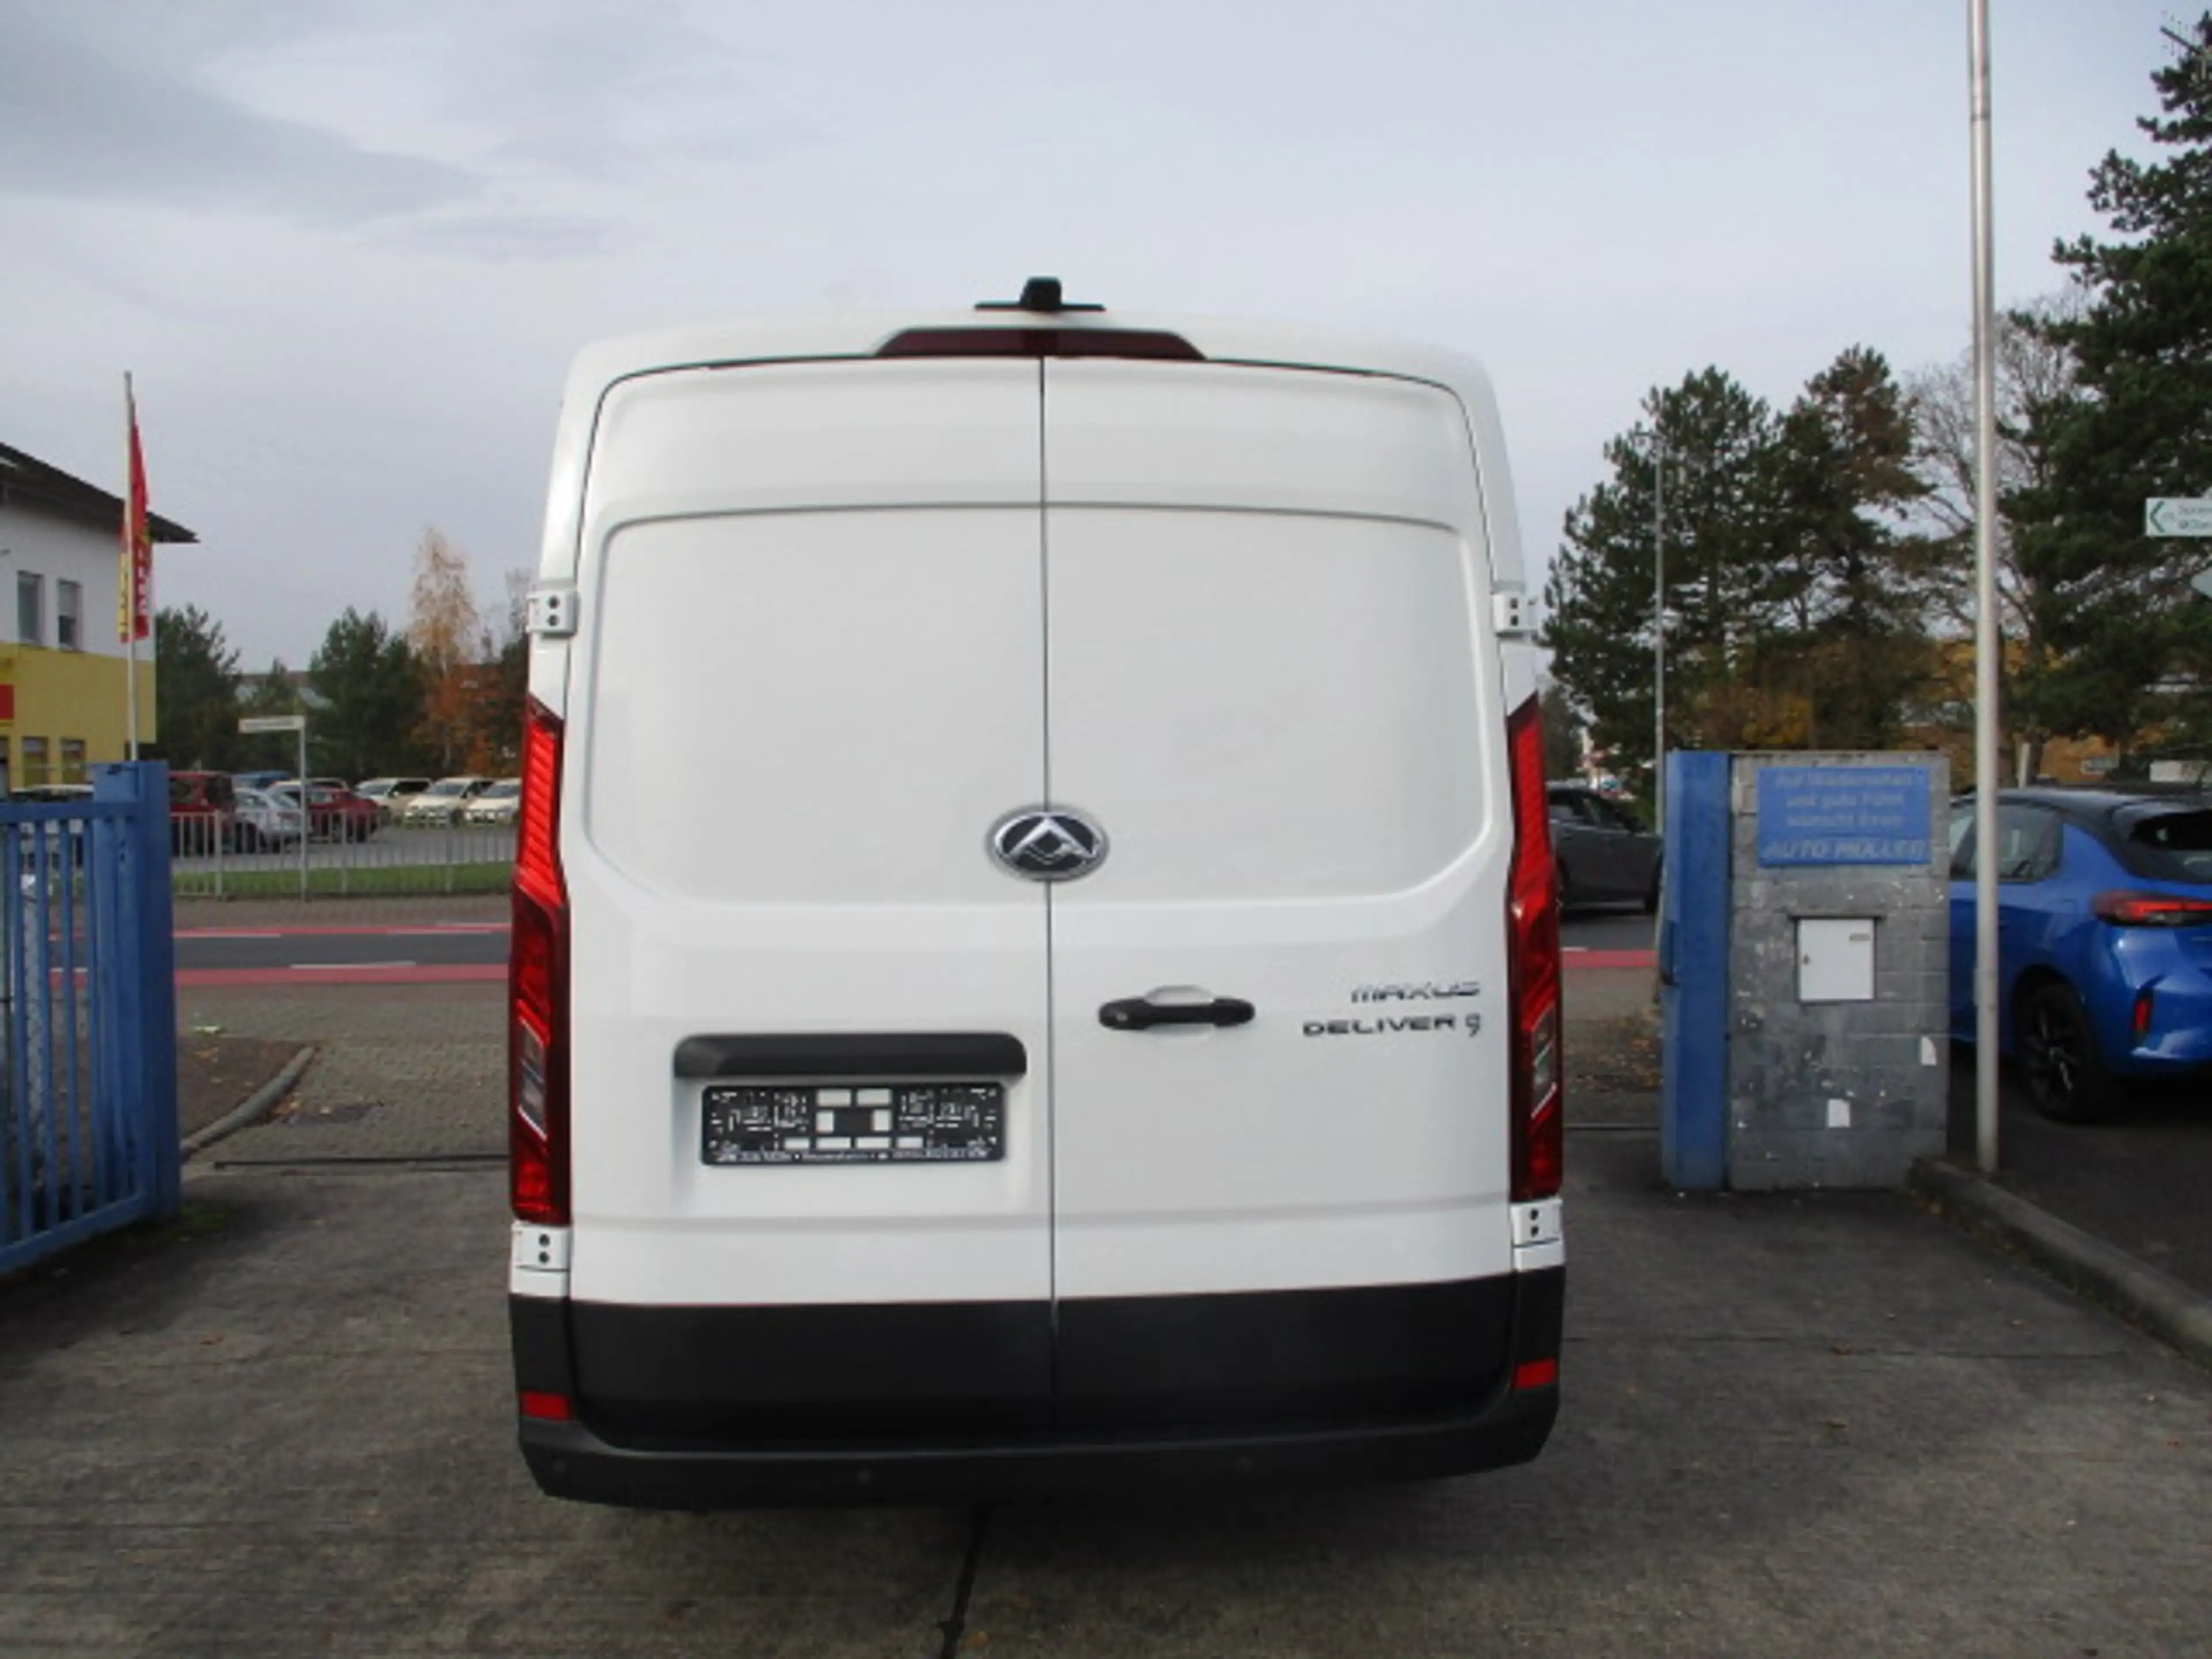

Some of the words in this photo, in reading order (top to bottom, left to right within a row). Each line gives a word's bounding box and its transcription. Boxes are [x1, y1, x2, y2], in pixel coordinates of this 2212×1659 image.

[1351, 981, 1480, 1003] MAXUS
[1302, 1014, 1456, 1037] DELIVER
[1465, 1012, 1481, 1037] 9
